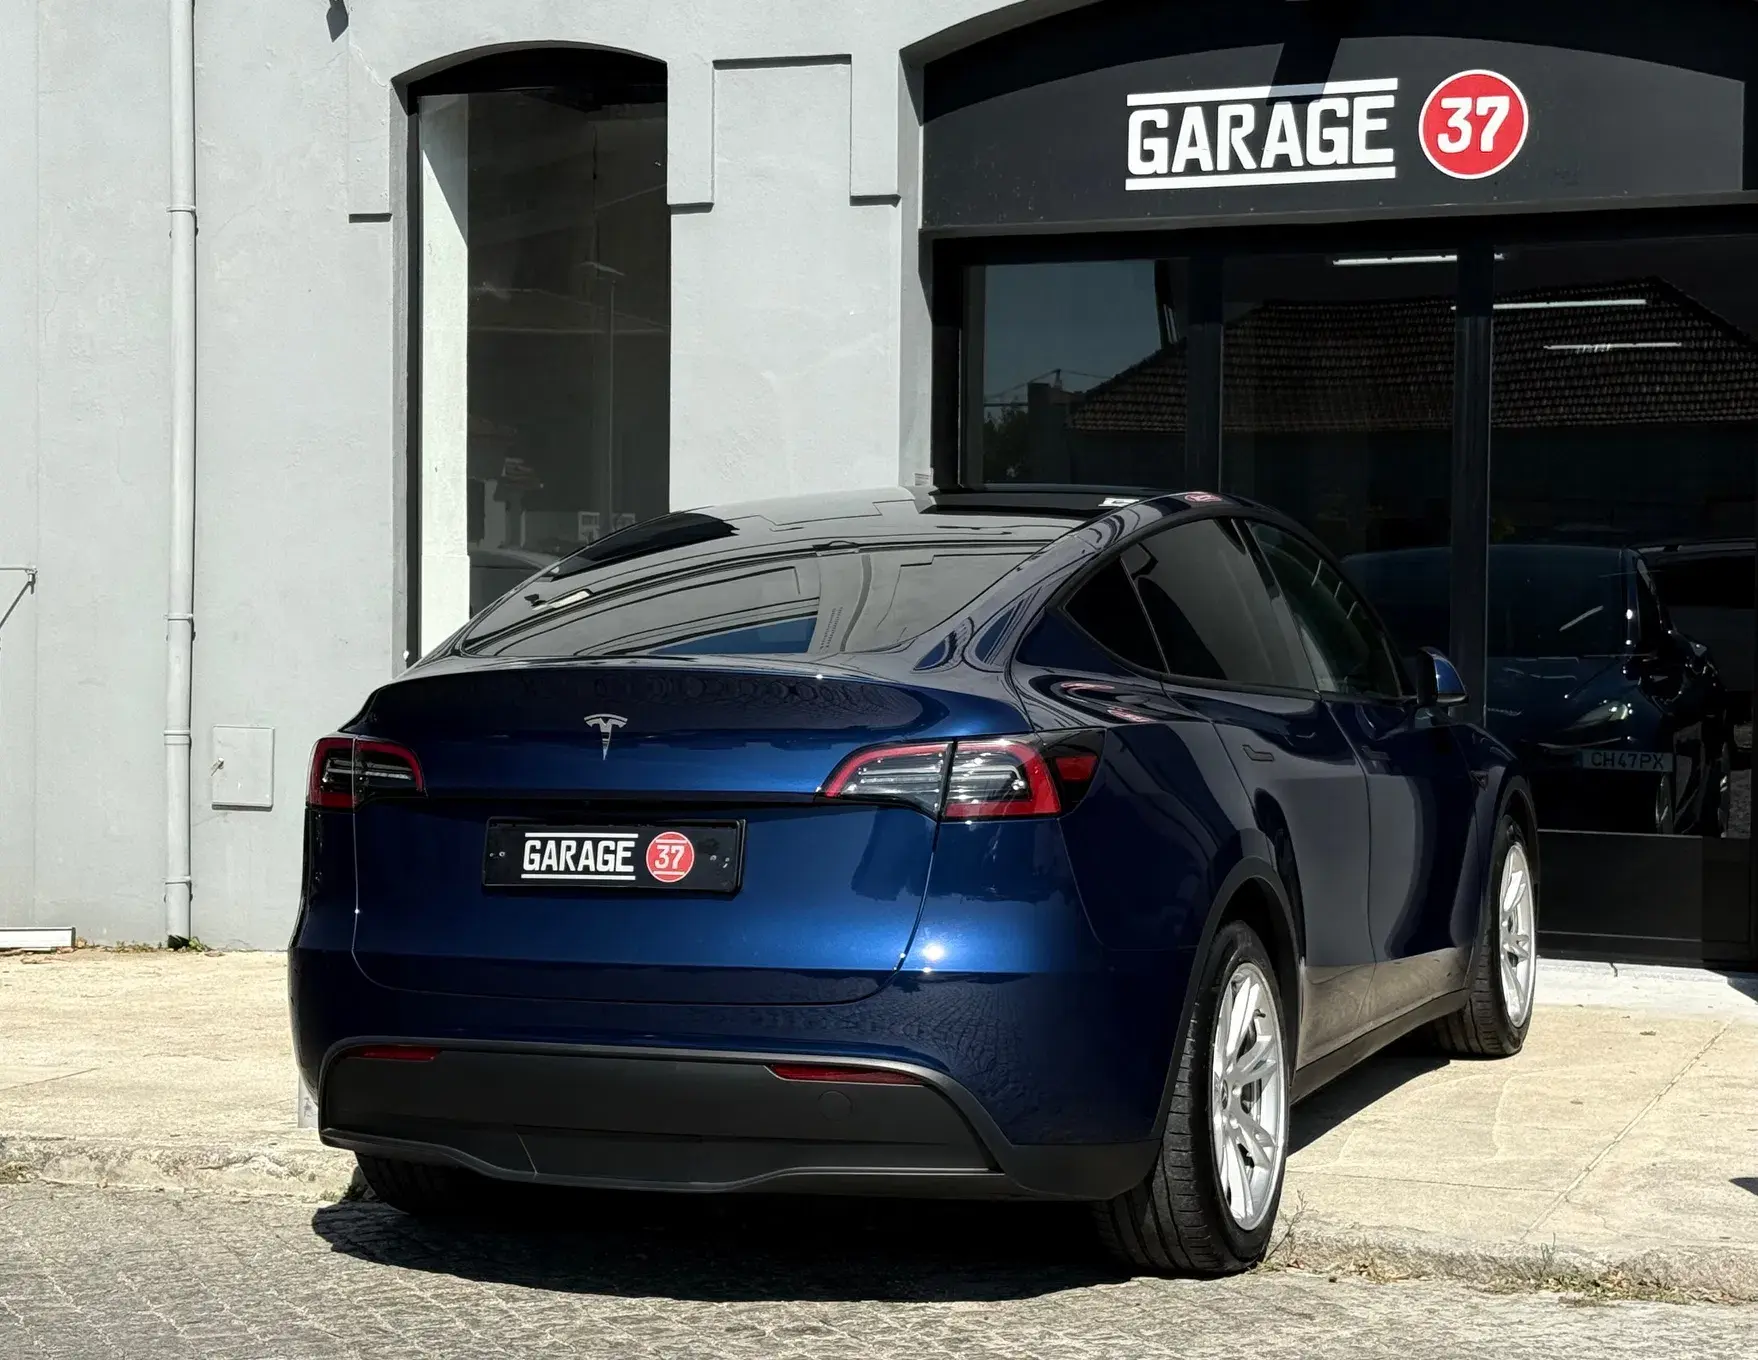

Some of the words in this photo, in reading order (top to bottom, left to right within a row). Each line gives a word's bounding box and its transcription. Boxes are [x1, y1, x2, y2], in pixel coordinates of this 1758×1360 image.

[1127, 95, 1395, 175] GARAGE
[1436, 95, 1510, 155] 37
[523, 840, 635, 872] GARAGE
[654, 845, 685, 869] 37
